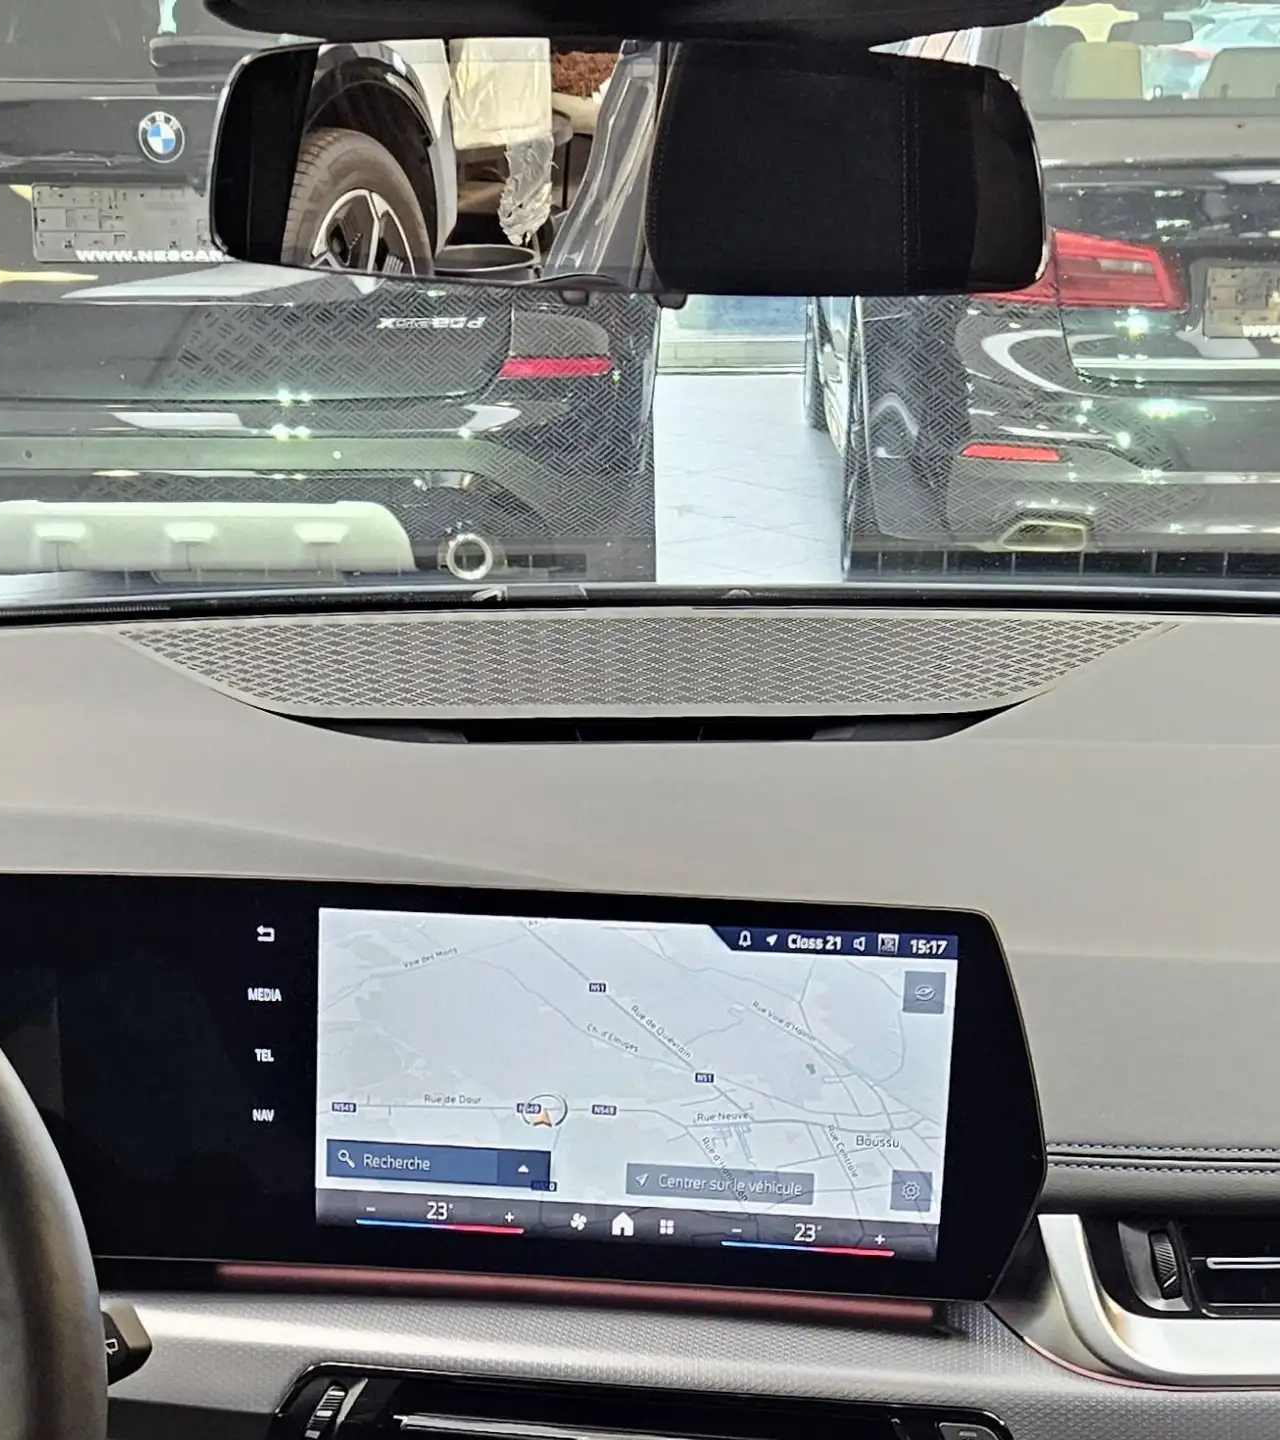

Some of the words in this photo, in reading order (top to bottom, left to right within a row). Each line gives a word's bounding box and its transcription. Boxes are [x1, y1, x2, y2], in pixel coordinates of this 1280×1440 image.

[787, 934, 824, 950] Class
[825, 935, 842, 950] 21
[910, 939, 948, 955] 15:17
[247, 987, 282, 1002] MEDIA
[631, 1004, 646, 1021] Rue
[255, 1049, 274, 1062] TEL
[424, 1094, 441, 1105] Rue
[444, 1095, 455, 1105] de
[458, 1095, 481, 1105] Dour
[252, 1110, 274, 1122] NAV
[697, 1111, 717, 1122] Rue
[718, 1111, 749, 1121] Neuve
[856, 1135, 899, 1149] Boussu
[363, 1153, 430, 1171] Recherche
[658, 1174, 706, 1190] Centrer
[709, 1180, 732, 1191] sur
[748, 1180, 803, 1196] véhicule
